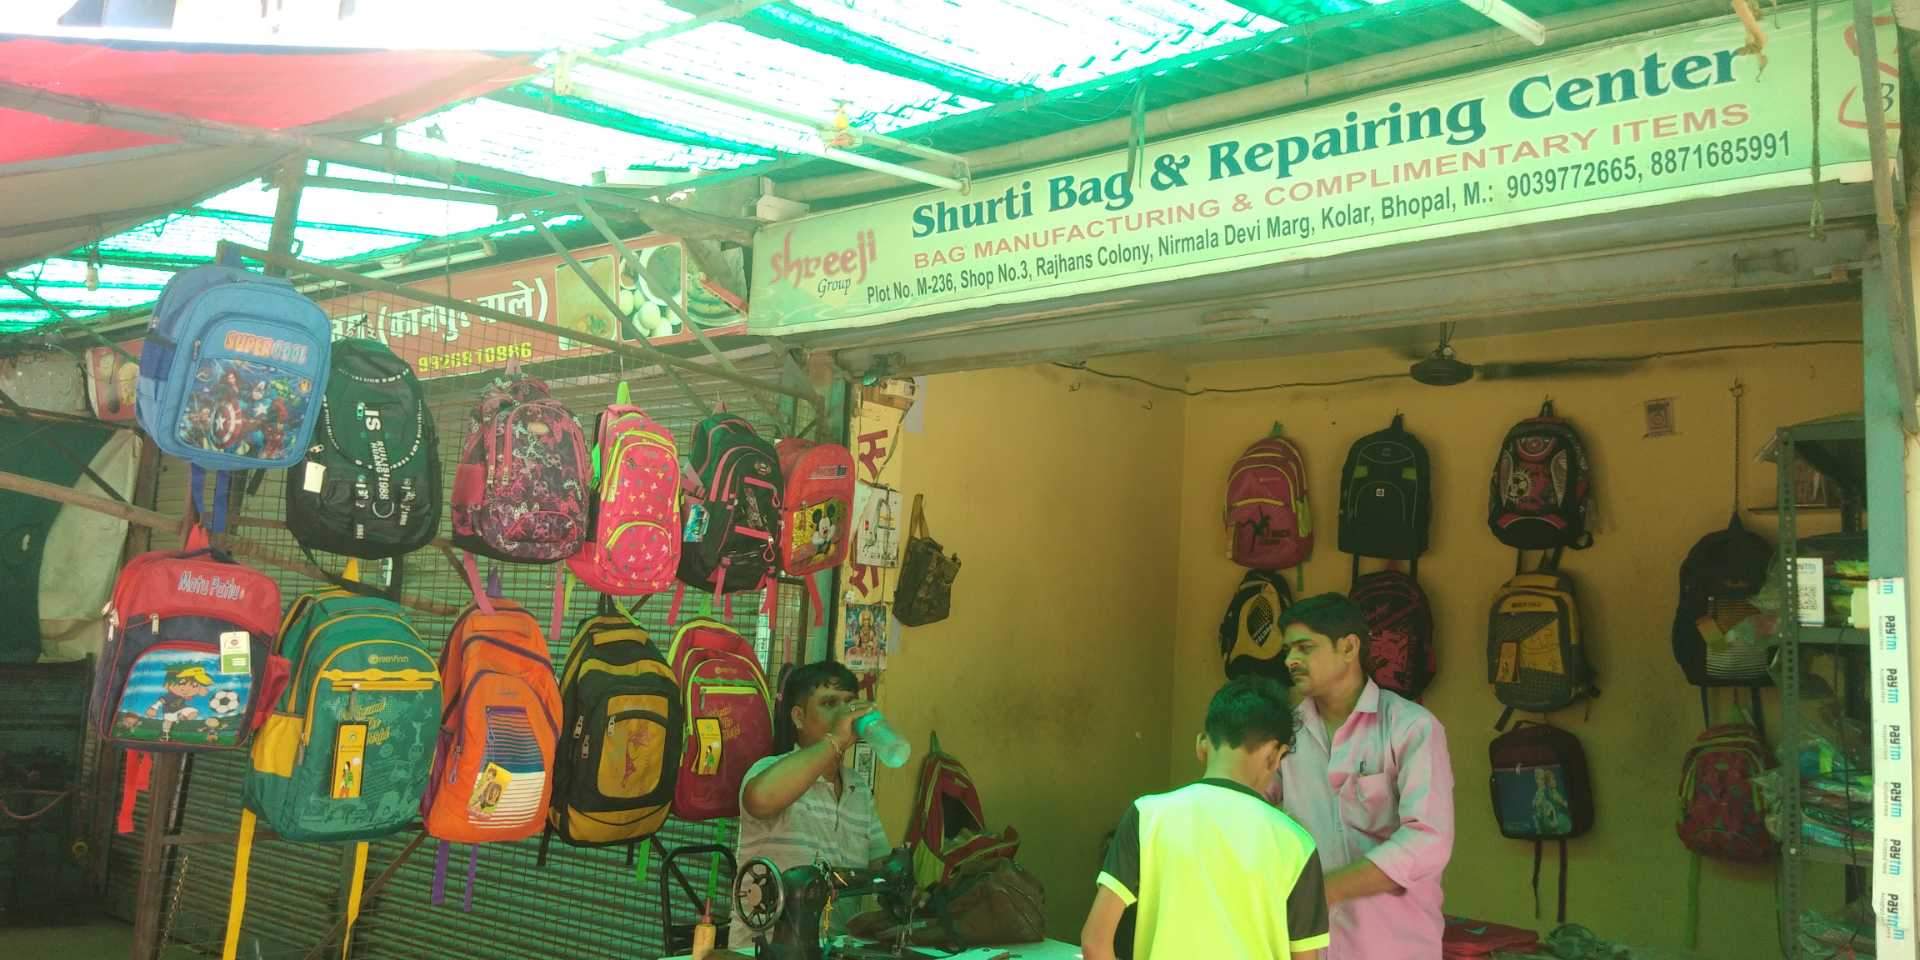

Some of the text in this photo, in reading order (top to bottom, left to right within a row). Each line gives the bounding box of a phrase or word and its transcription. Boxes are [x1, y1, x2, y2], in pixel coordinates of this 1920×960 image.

[867, 284, 890, 305] Plot
[893, 280, 914, 302] No.
[917, 274, 957, 297] M-236,
[960, 270, 994, 293] Shop
[997, 260, 1033, 285] No.3,
[1036, 252, 1093, 280] Rajhans
[1097, 243, 1154, 274] Colony,
[1158, 228, 1219, 258] Nirmala
[1225, 219, 1261, 245] Devi
[1267, 211, 1316, 240] Marg,
[1321, 201, 1375, 231] Kolar,
[1381, 185, 1457, 222] Bhopal,
[1507, 154, 1643, 199] 9039772665,
[1651, 129, 1791, 176] 8871685991
[913, 48, 1739, 239] Shurti Bag & Repairing Center
[914, 103, 1750, 269] BAG MANUFACTURING & COMPLIMENTARY ITEMS
[817, 277, 852, 298] Group
